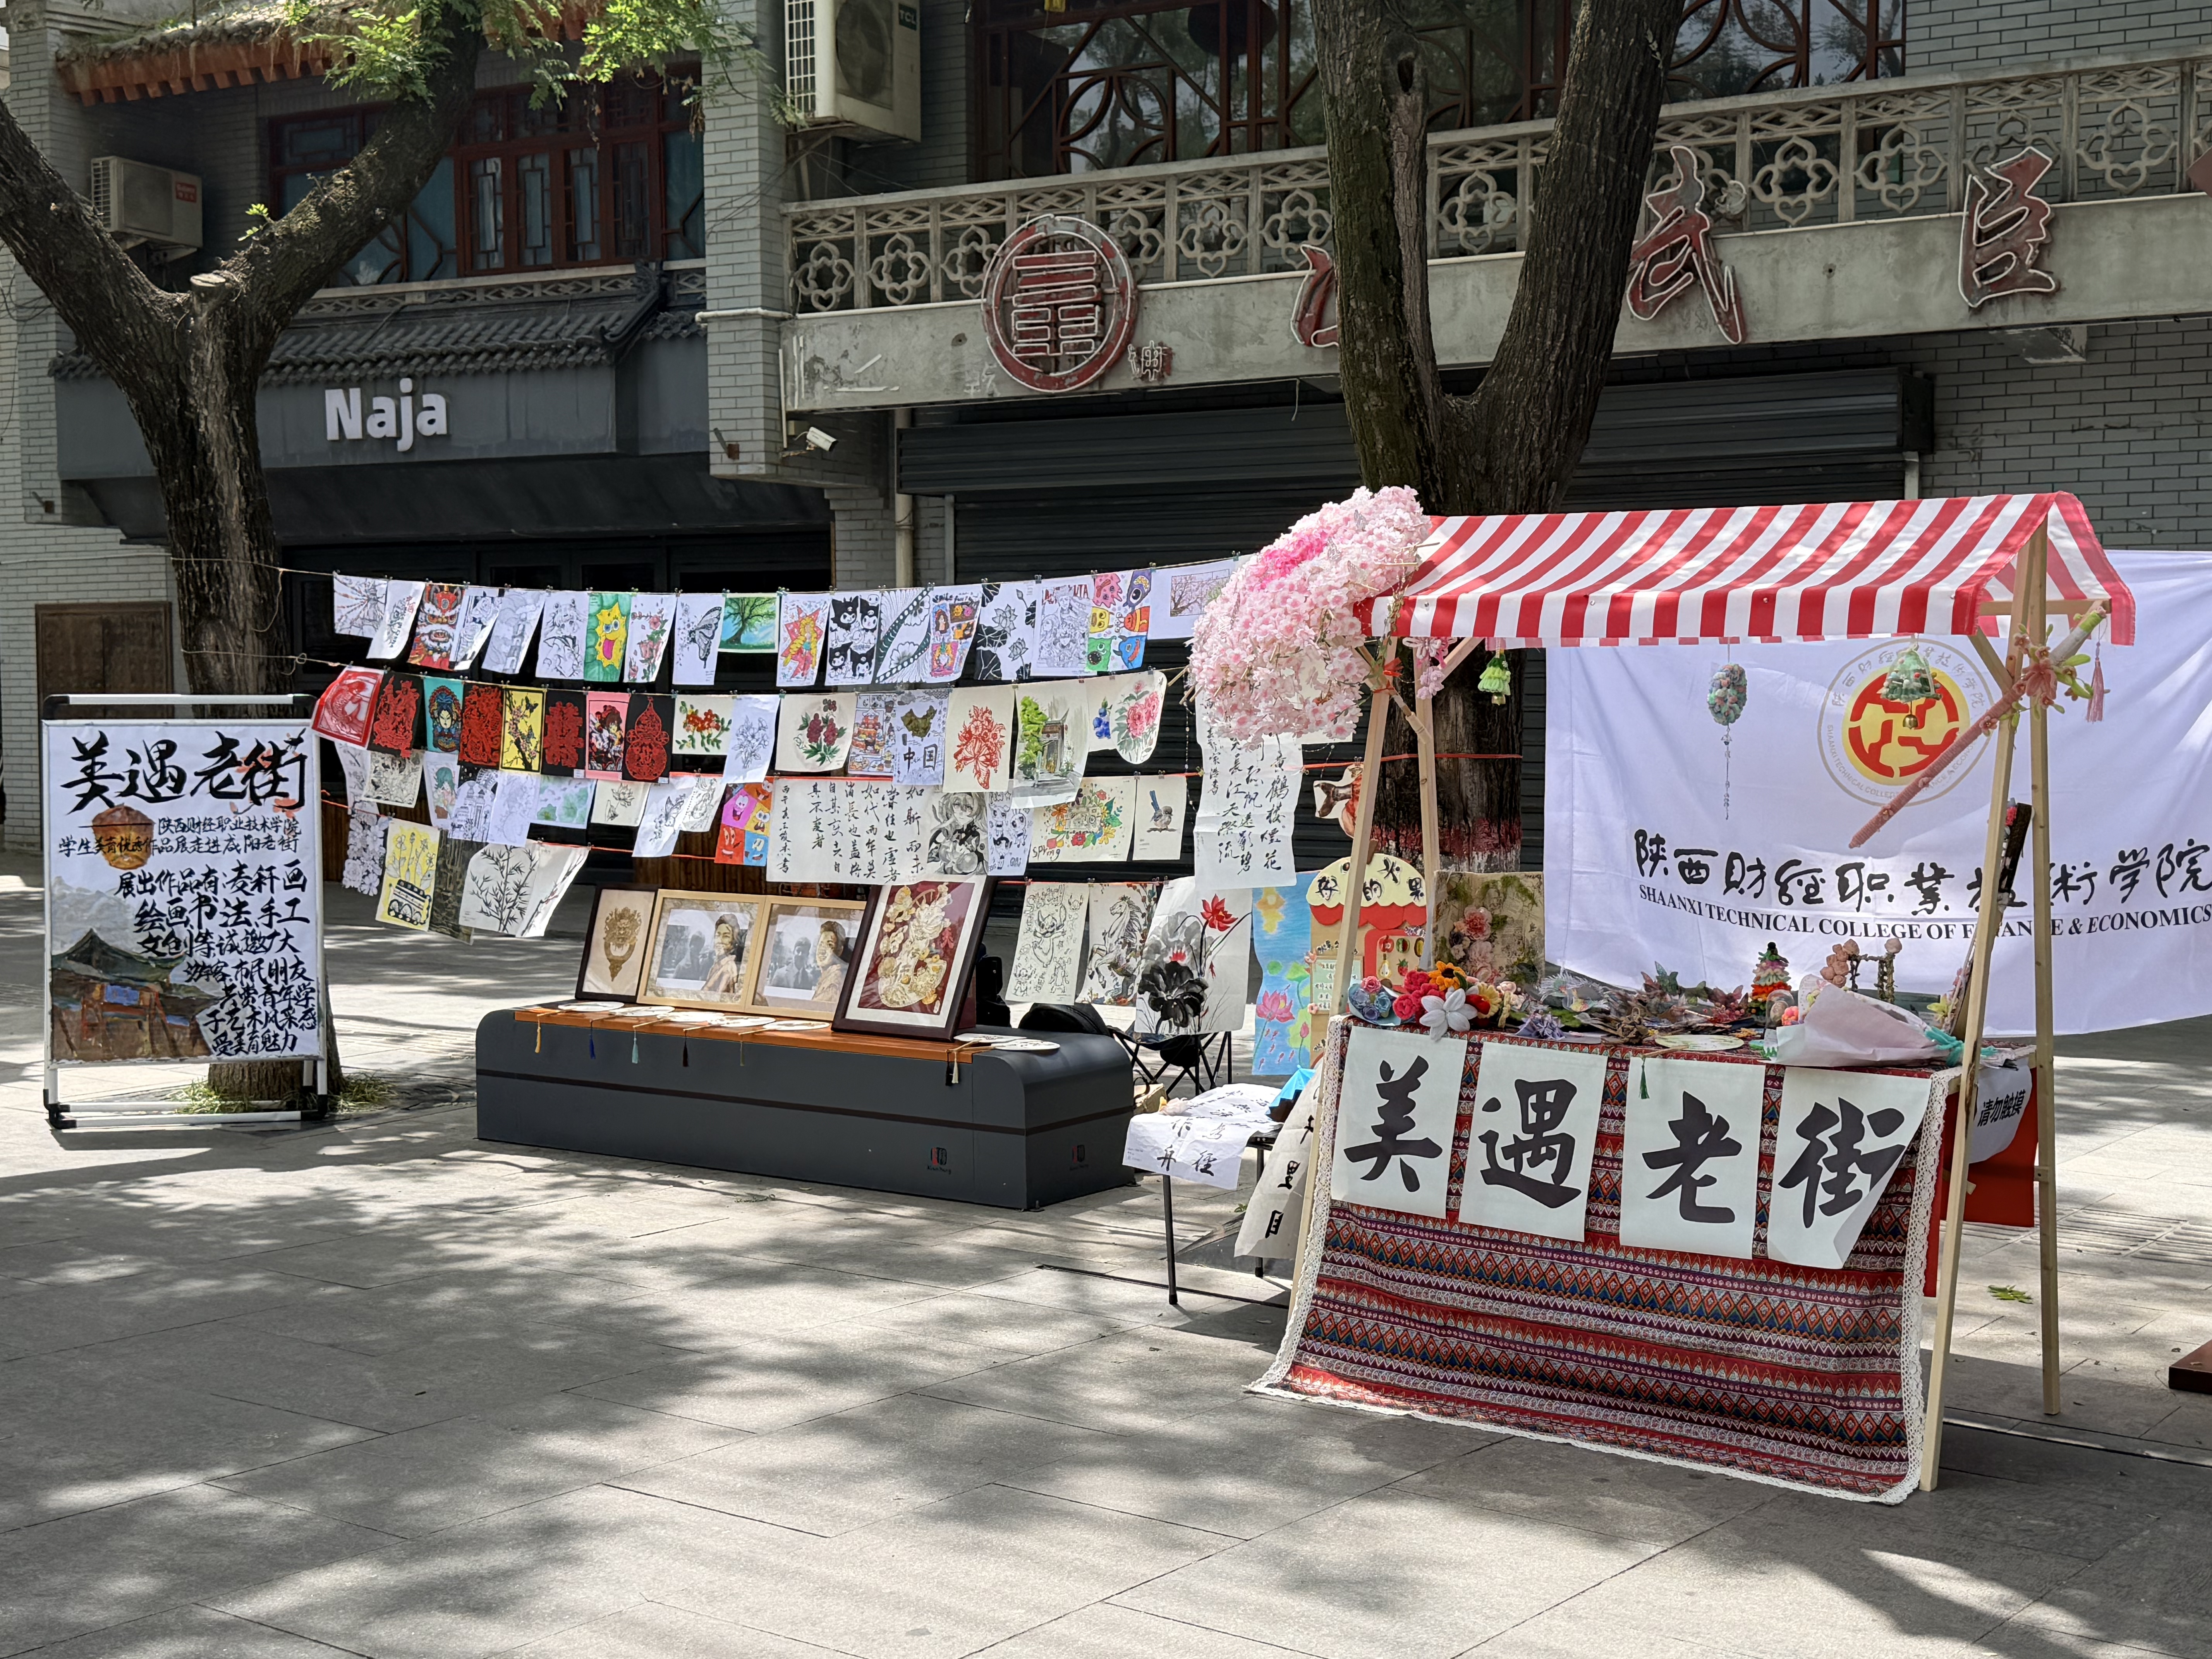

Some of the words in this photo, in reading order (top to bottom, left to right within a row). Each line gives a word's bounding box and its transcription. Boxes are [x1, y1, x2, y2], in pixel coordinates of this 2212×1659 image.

[325, 378, 447, 452] Naja
[60, 728, 308, 815] 美遇老街
[903, 744, 938, 773] 中国
[158, 815, 302, 835] 陕西财经职业技术学院
[58, 833, 300, 857] 学生美育优秀作品展走进咸阳老街
[1639, 884, 1704, 917] SHAANXI
[1705, 903, 1814, 933] TECHNICAL
[1819, 918, 1922, 939] COLLEGE
[1926, 923, 1956, 940] OF
[1961, 919, 2063, 939] FANE
[2068, 917, 2084, 935] &
[2086, 903, 2212, 934] ECONOMICS
[212, 1028, 298, 1057] 受美育魅力
[1977, 1089, 2026, 1128] 请勿触摸
[1344, 1054, 1906, 1228] 美遇老街
